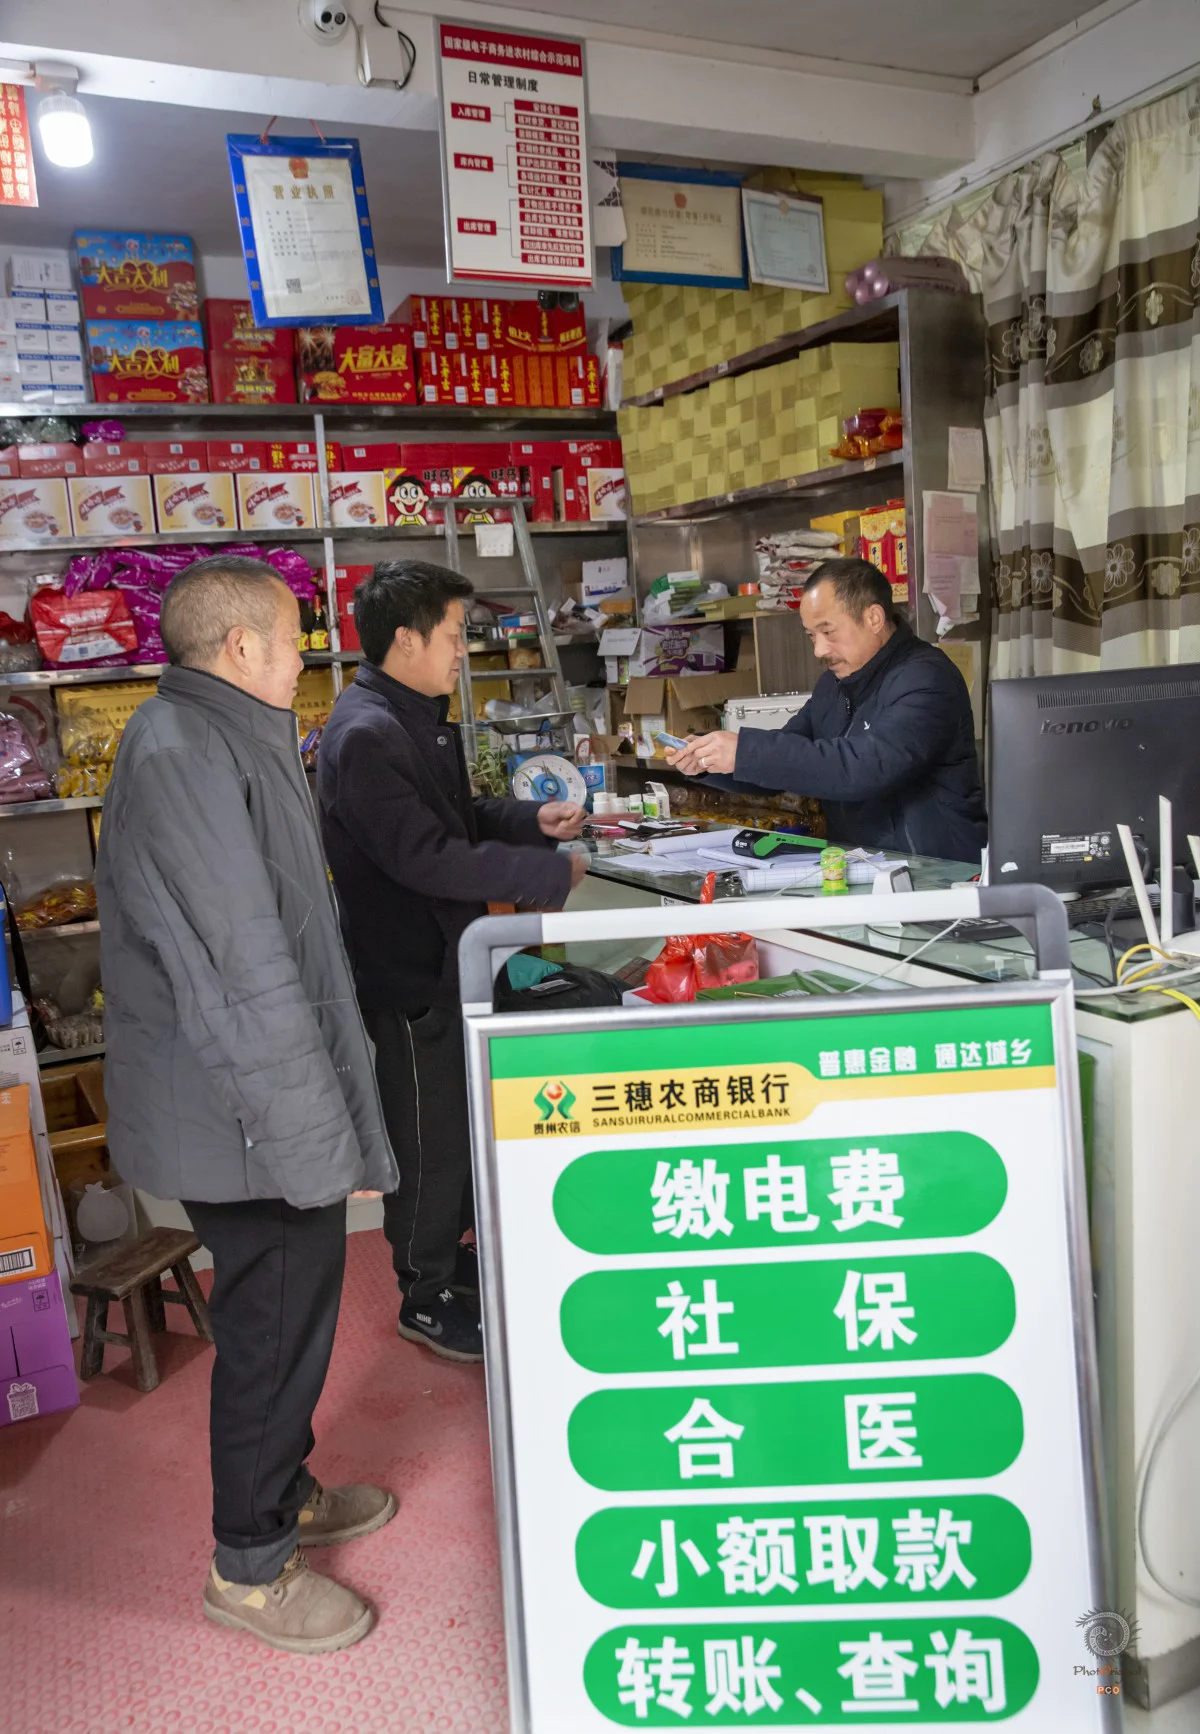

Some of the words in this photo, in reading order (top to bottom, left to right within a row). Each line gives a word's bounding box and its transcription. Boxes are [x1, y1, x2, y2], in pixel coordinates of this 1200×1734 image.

[444, 36, 580, 68] 国家级电子商务进农村综合示范项目
[468, 71, 539, 92] 日常管理制度
[273, 184, 336, 200] 营业执照
[338, 344, 408, 373] 大富大贵
[423, 468, 452, 482] 旺仔
[430, 482, 452, 493] 牛奶
[490, 468, 519, 482] 旺仔
[497, 482, 519, 493] 牛奶
[1040, 718, 1133, 735] lenovo
[818, 1045, 917, 1078] 普惠金融
[935, 1038, 1033, 1071] 通达城乡
[592, 1073, 789, 1114] 三穗农商银行
[534, 1121, 581, 1136] 贵州农信
[593, 1107, 791, 1128] SANSUIRURALCOMMERCIALBANK
[650, 1147, 906, 1240] 缴电费
[656, 1270, 917, 1361] 社保
[664, 1392, 923, 1479] 合医
[631, 1508, 977, 1598] 小额取款
[614, 1628, 1007, 1719] 转账、查询
